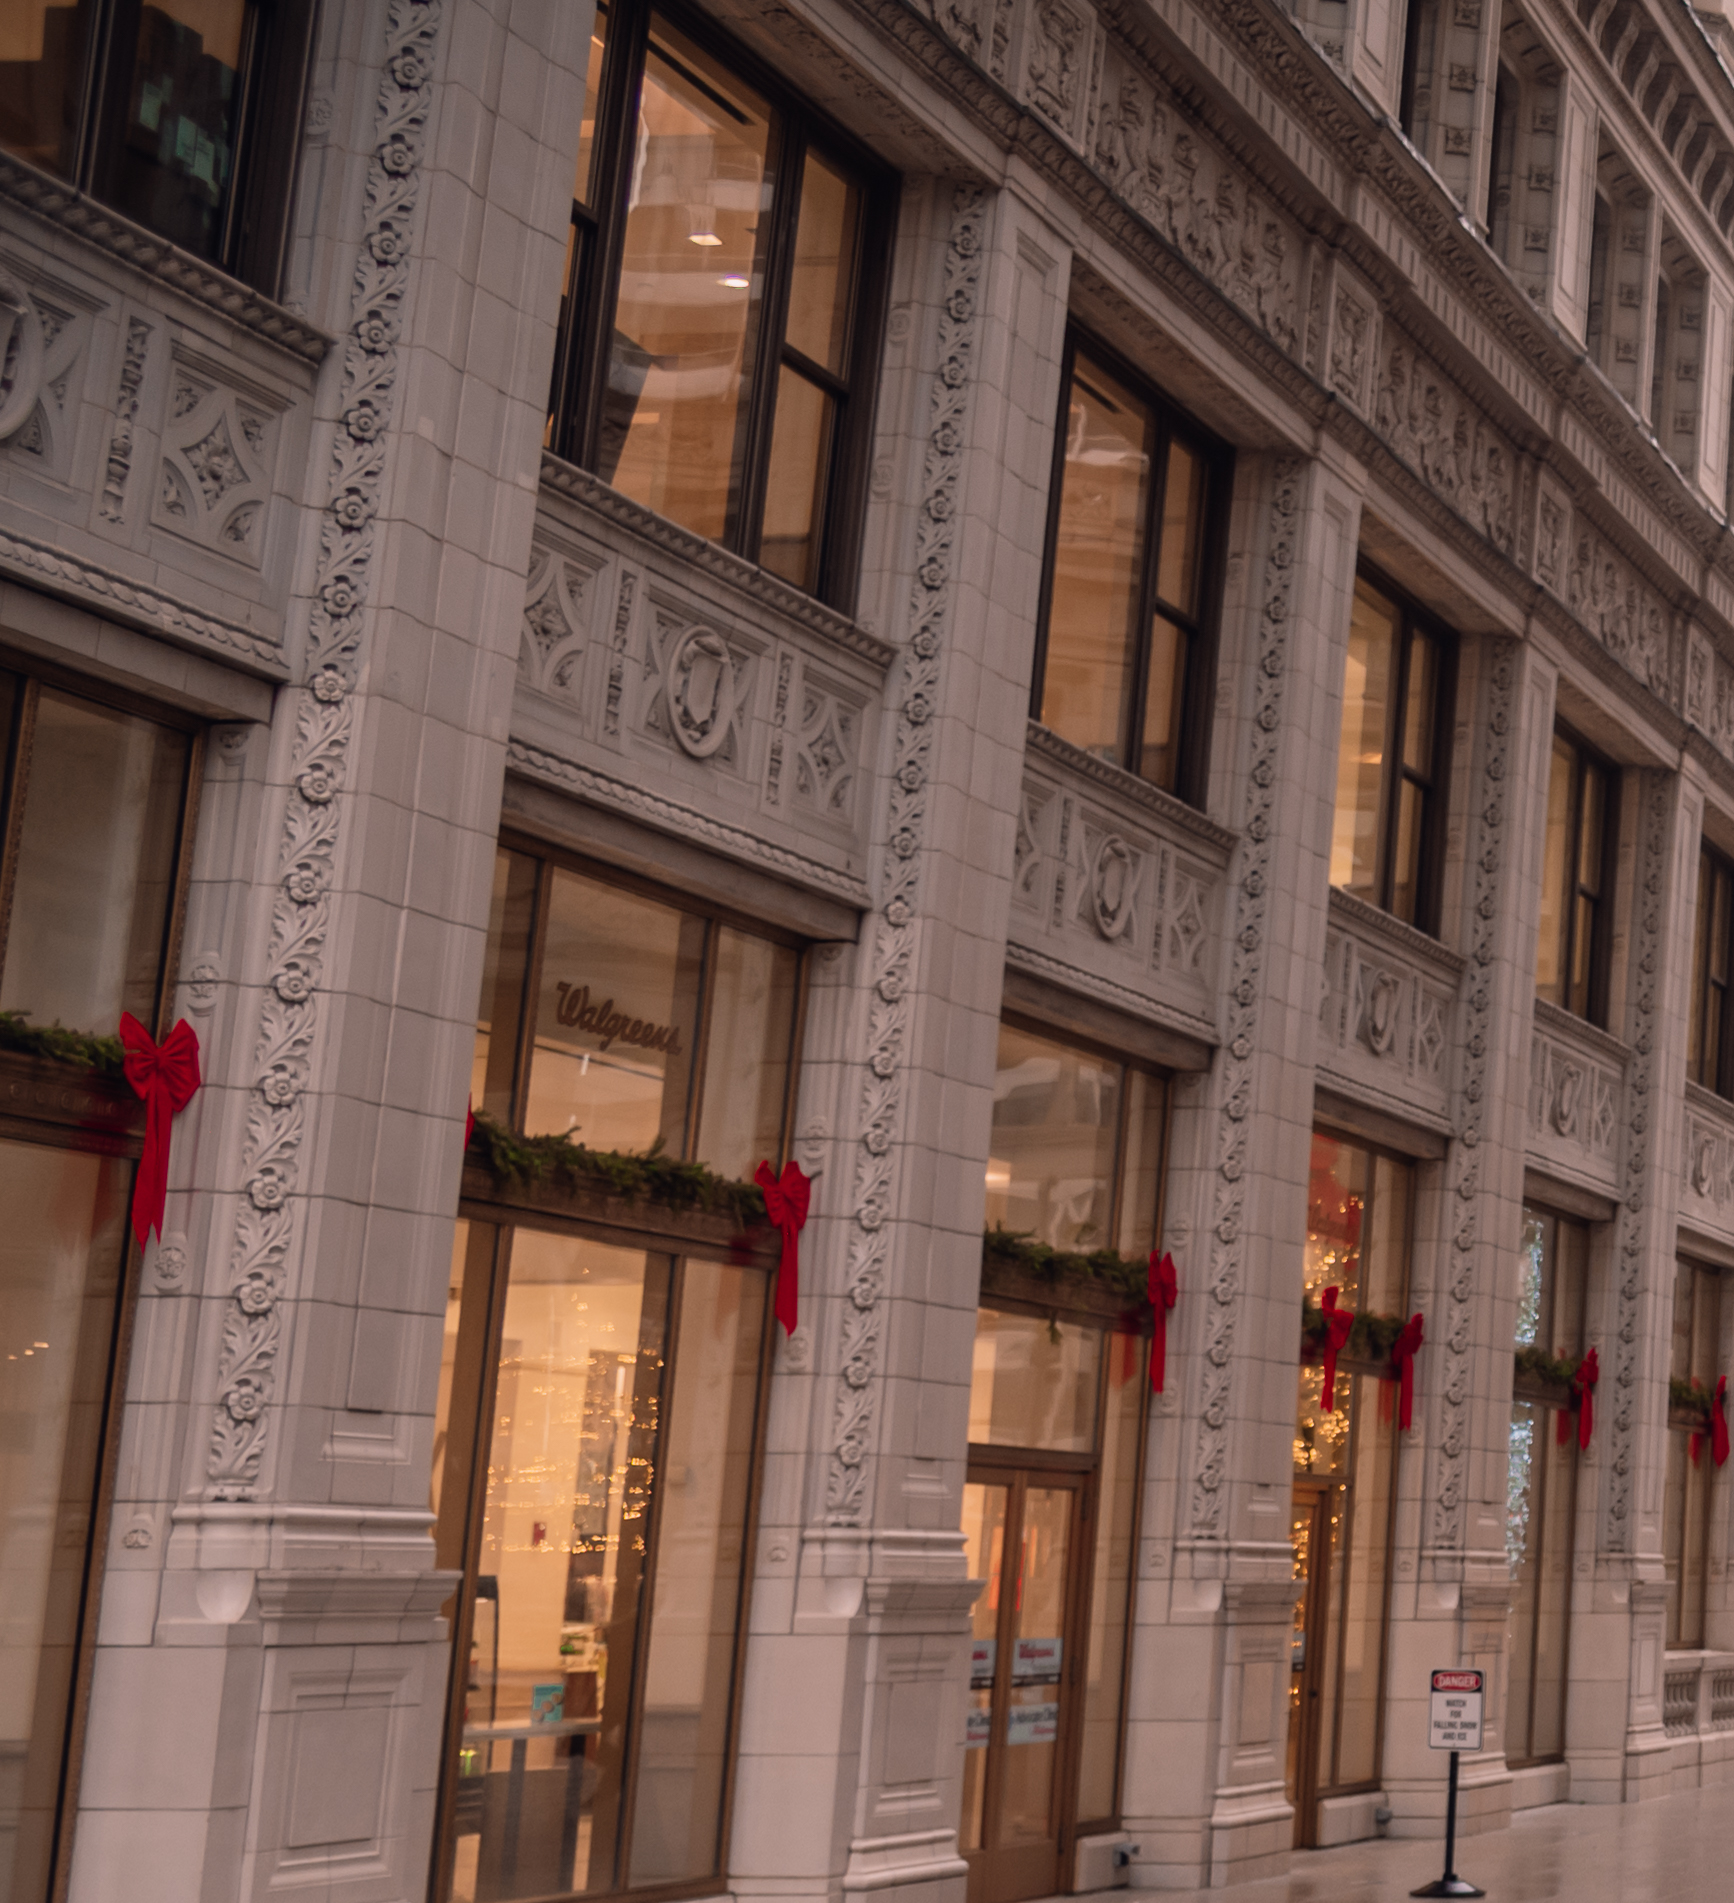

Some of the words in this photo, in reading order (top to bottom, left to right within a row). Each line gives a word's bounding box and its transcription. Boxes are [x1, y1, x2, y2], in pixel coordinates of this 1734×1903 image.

[556, 981, 682, 1056] Walgreens
[1439, 1676, 1476, 1687] DANGER
[1445, 1699, 1466, 1707] WATCH
[1450, 1710, 1462, 1718] FOR
[1433, 1721, 1457, 1729] FALLING
[1460, 1721, 1477, 1729] SNOW
[1442, 1732, 1455, 1740] AND
[1457, 1732, 1467, 1740] ICE
